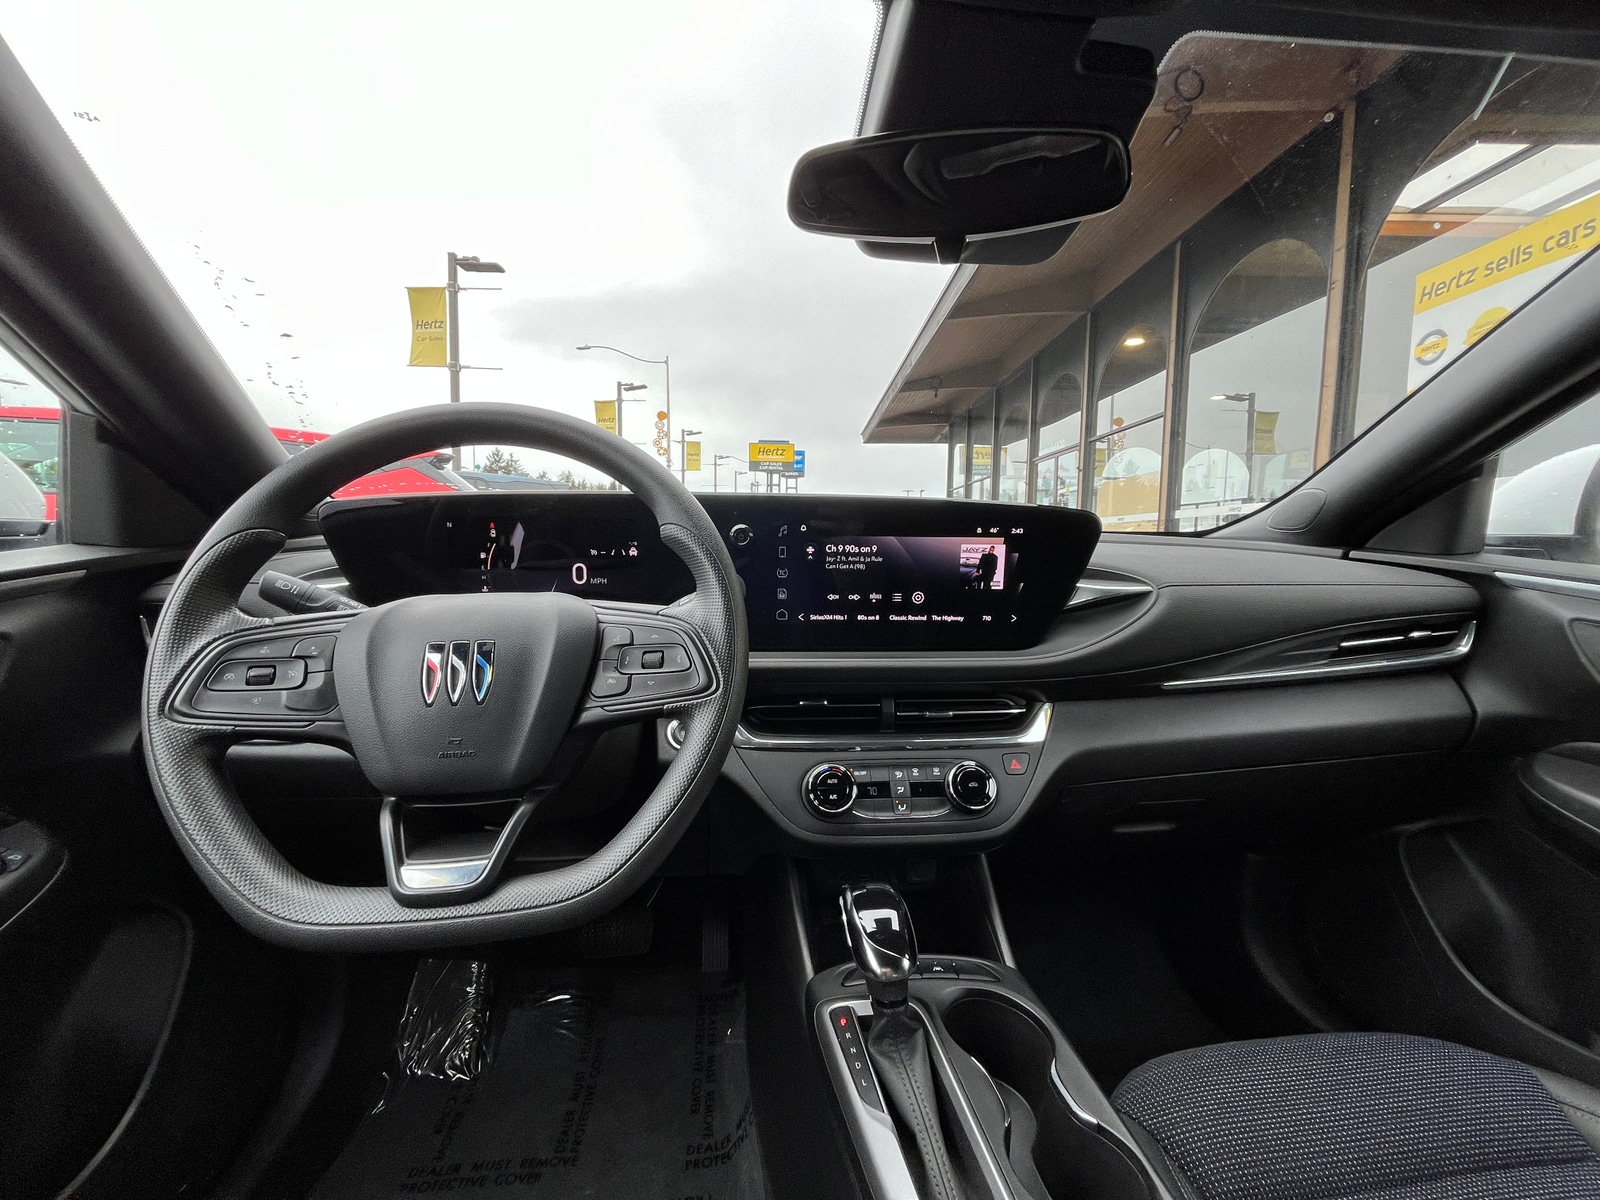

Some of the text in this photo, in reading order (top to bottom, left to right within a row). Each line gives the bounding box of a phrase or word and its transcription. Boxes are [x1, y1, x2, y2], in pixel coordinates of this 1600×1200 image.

[1418, 218, 1597, 304] Hertz sells cars
[416, 319, 444, 330] Hertz
[757, 446, 787, 457] Hertz
[825, 544, 837, 553] Ch
[837, 544, 844, 553] 9
[844, 544, 860, 553] 90s
[871, 544, 878, 553] 9
[572, 562, 588, 585] 0
[942, 614, 965, 623] Highway
[437, 750, 478, 759] AIRBAG
[866, 786, 878, 796] 70
[840, 1018, 847, 1027] P
[850, 1046, 857, 1054] N
[689, 1080, 702, 1116] COVER
[702, 1089, 716, 1141] REMOVE
[685, 1133, 731, 1156] DEALER
[406, 1155, 579, 1179] DEALER MUST REMOVE
[398, 1172, 543, 1194] PROTECTIVE COVER
